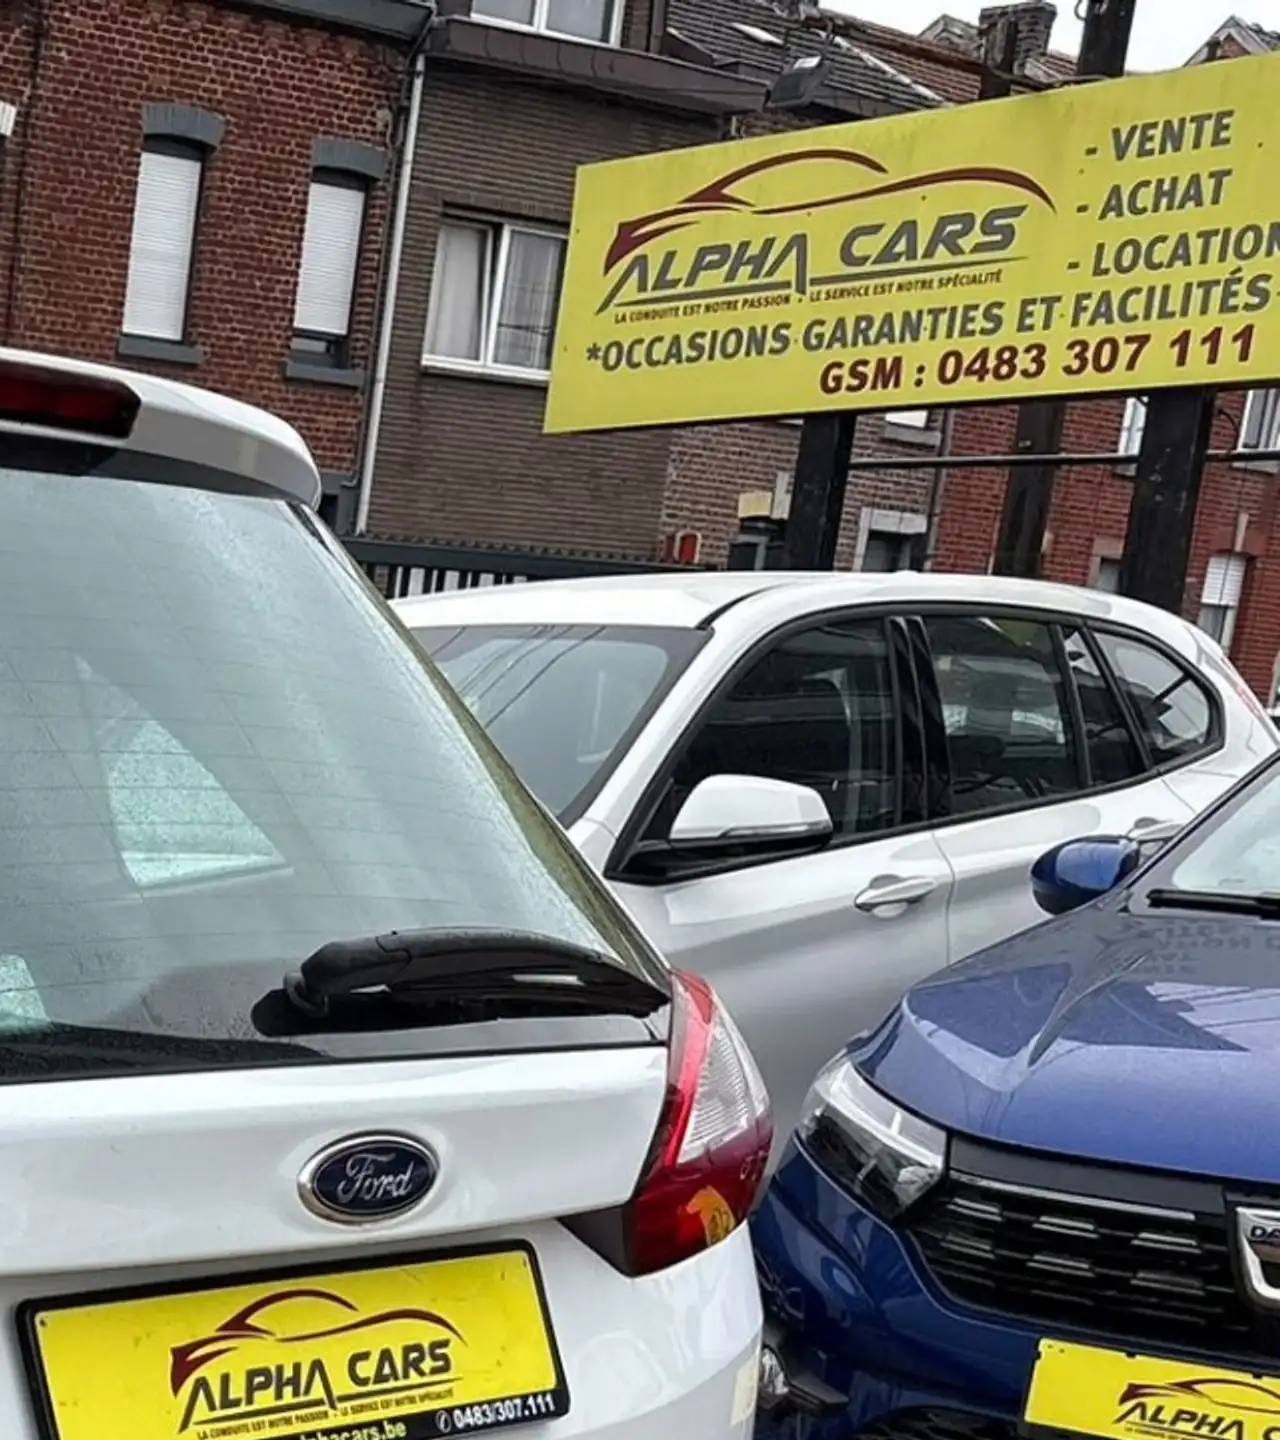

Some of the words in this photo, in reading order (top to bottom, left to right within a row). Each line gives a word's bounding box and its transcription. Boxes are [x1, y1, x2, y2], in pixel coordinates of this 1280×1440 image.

[1111, 109, 1235, 161] VENTE
[1098, 168, 1233, 221] ACHAT
[594, 232, 807, 317] ALPHA
[840, 204, 1029, 267] CARS
[614, 313, 627, 325] LA
[629, 306, 681, 323] CONDUITE
[682, 303, 702, 317] EST
[704, 299, 739, 314] NOTRE
[741, 294, 791, 310] PASSION
[809, 290, 822, 302] LE
[824, 284, 870, 301] SERVICE
[873, 281, 893, 295] EST
[896, 277, 934, 293] NOTRE
[937, 268, 1003, 289] SPÉCIALITÉ
[802, 300, 1006, 352] GARANTIES
[1016, 294, 1063, 334] ET
[1071, 266, 1274, 328] FACILITÉS
[819, 356, 904, 395] GSM
[938, 342, 1047, 386] 0483
[1061, 333, 1152, 377] 307
[1169, 323, 1256, 368] 111
[337, 1152, 415, 1204] Ford
[177, 1358, 339, 1435] ALPHA
[347, 1338, 452, 1387] CARS
[452, 1392, 556, 1430] 0483/307.111
